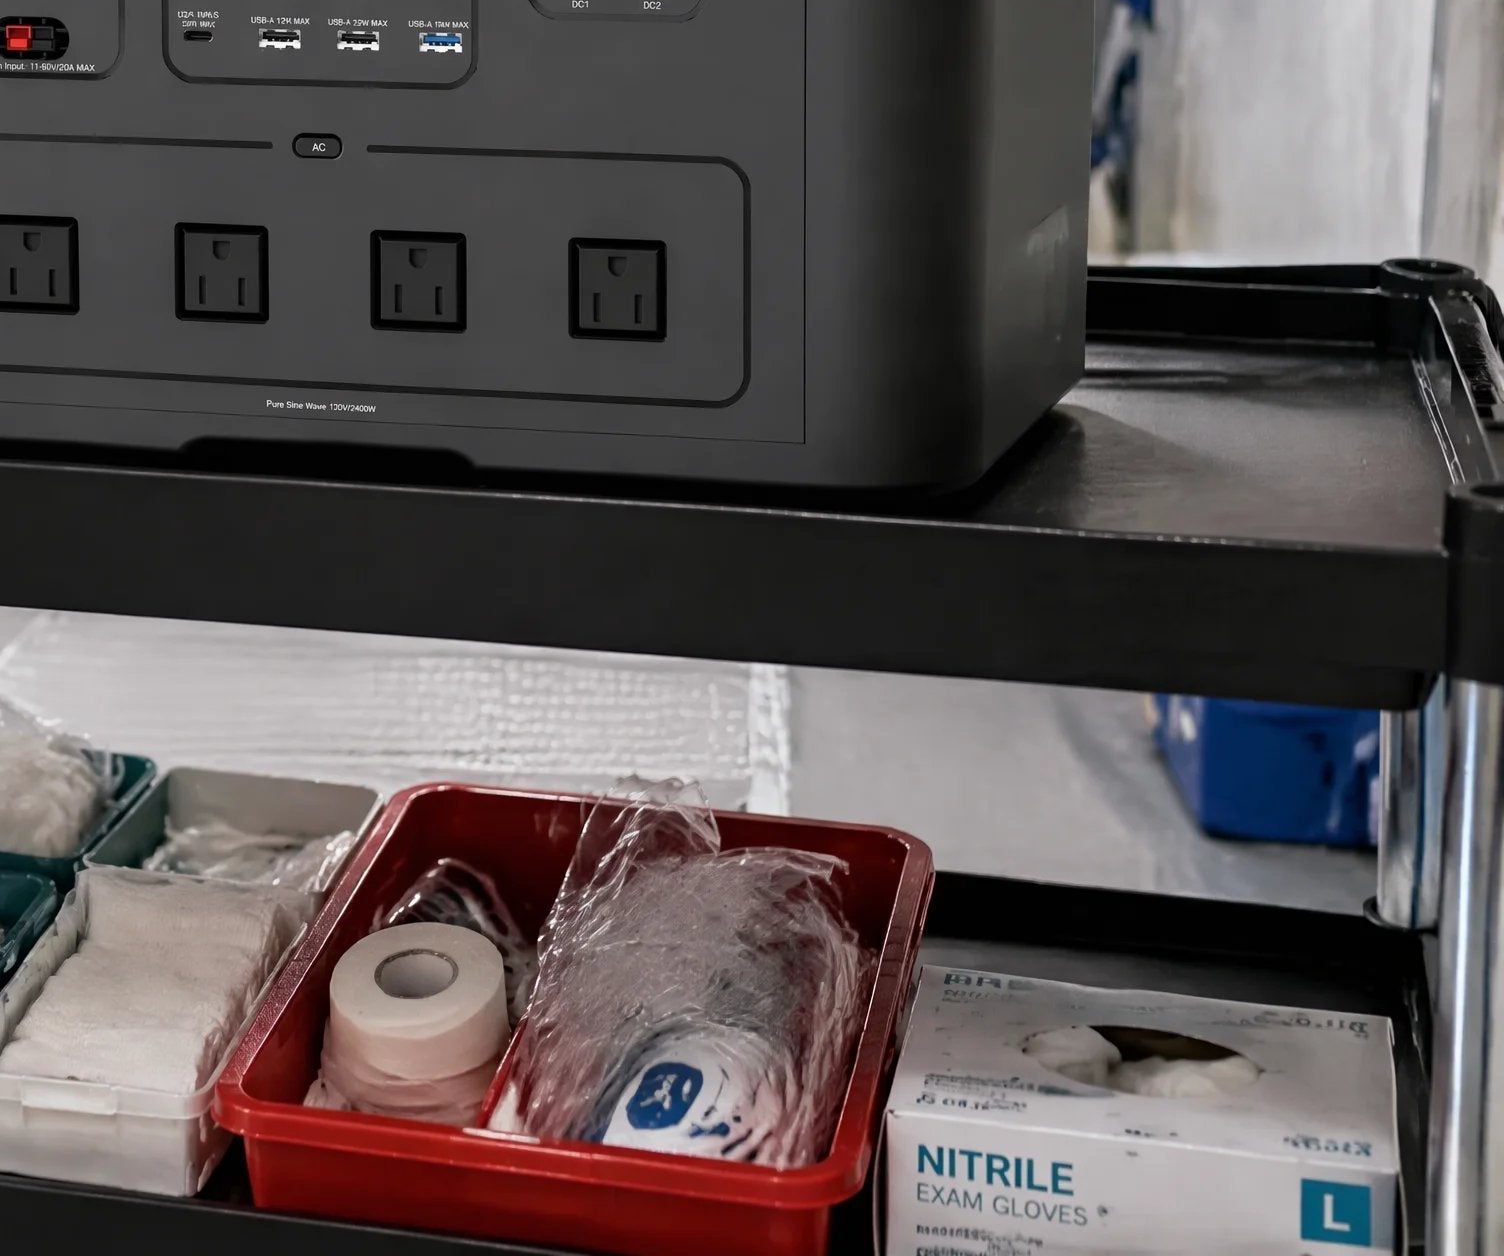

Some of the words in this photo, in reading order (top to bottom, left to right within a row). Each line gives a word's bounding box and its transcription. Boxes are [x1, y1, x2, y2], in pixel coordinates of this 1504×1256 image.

[571, 0, 589, 9] DC1
[643, 1, 662, 10] DC2
[293, 17, 310, 25] MAX
[327, 18, 351, 27] USB-A
[371, 19, 388, 27] MAX
[408, 20, 433, 29] USB-A
[452, 21, 469, 29] MAX
[76, 64, 96, 72] MAX
[312, 142, 326, 152] AC
[266, 399, 285, 409] Pure
[286, 401, 304, 410] Sine
[916, 1144, 1075, 1197] NITRILE
[916, 1183, 983, 1215] EXAM
[991, 1193, 1089, 1228] GLOVES
[1322, 1193, 1351, 1232] L
